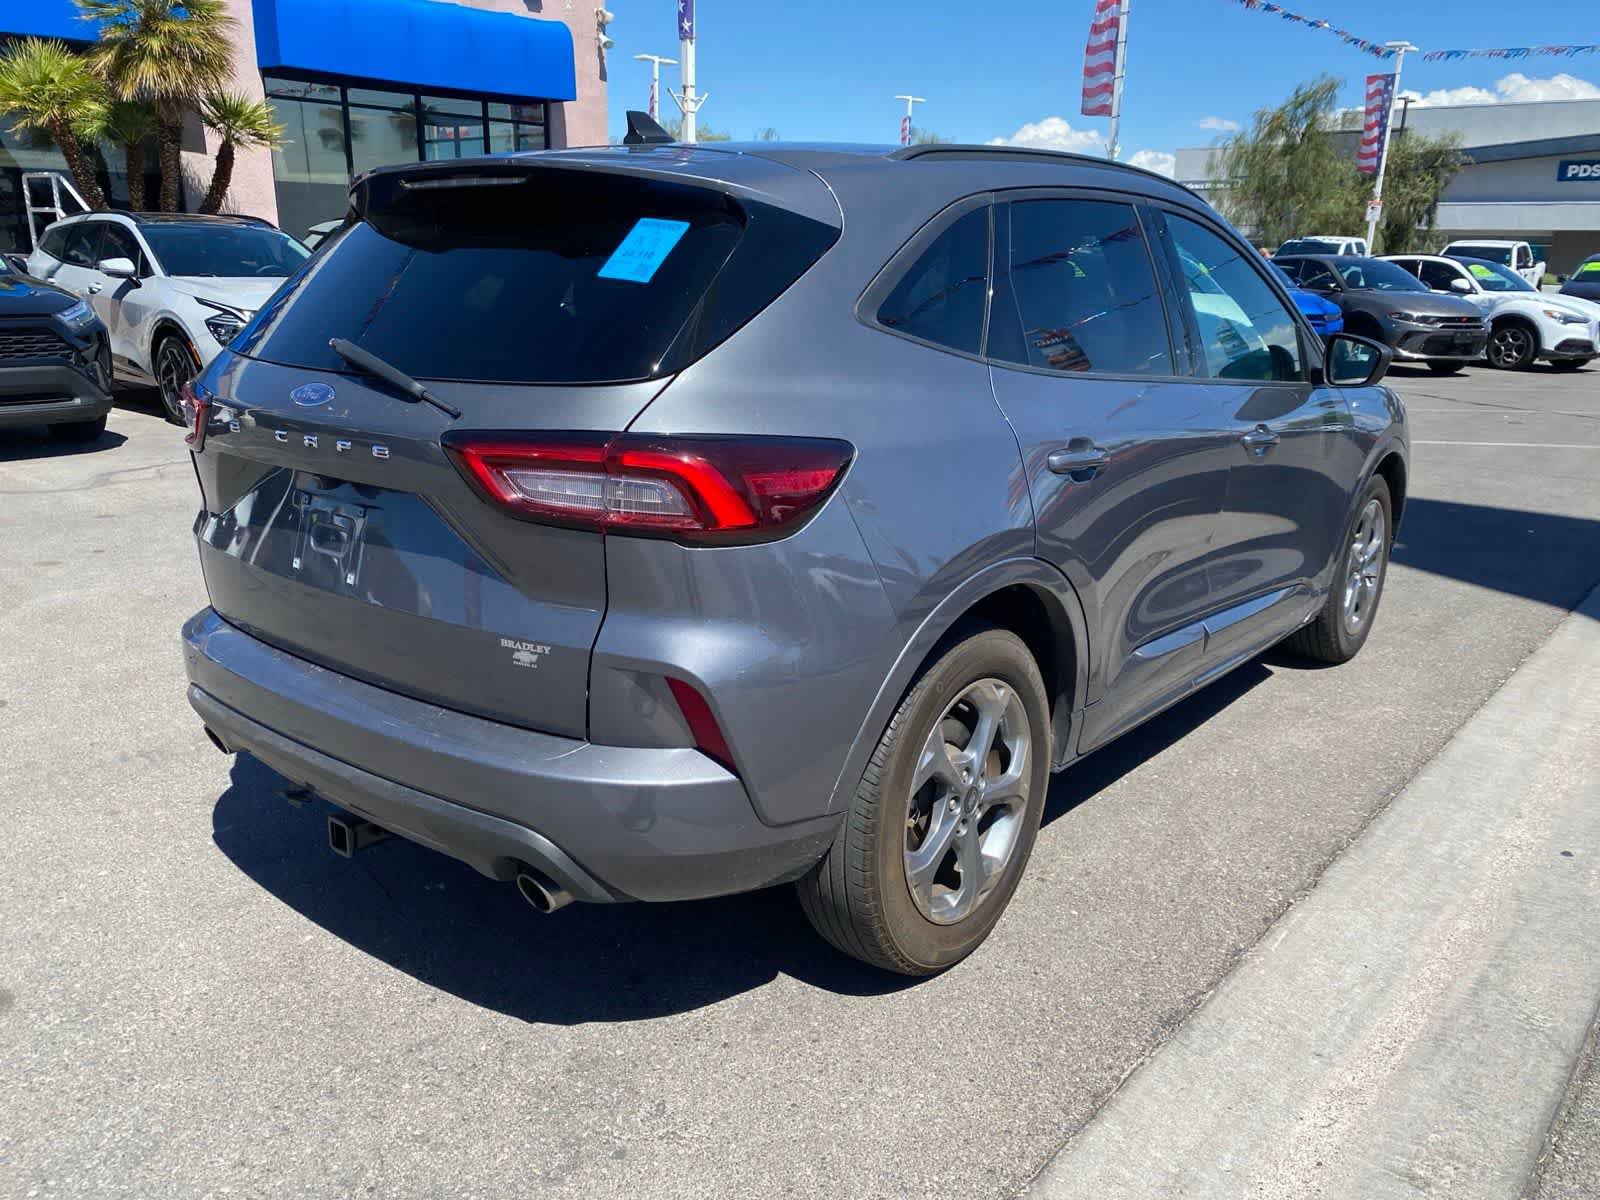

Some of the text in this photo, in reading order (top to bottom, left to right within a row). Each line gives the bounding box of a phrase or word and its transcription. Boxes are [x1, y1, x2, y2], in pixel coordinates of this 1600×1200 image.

[1567, 164, 1600, 177] PDS
[228, 418, 390, 460] ECAPE
[500, 638, 552, 654] BRADLEY
